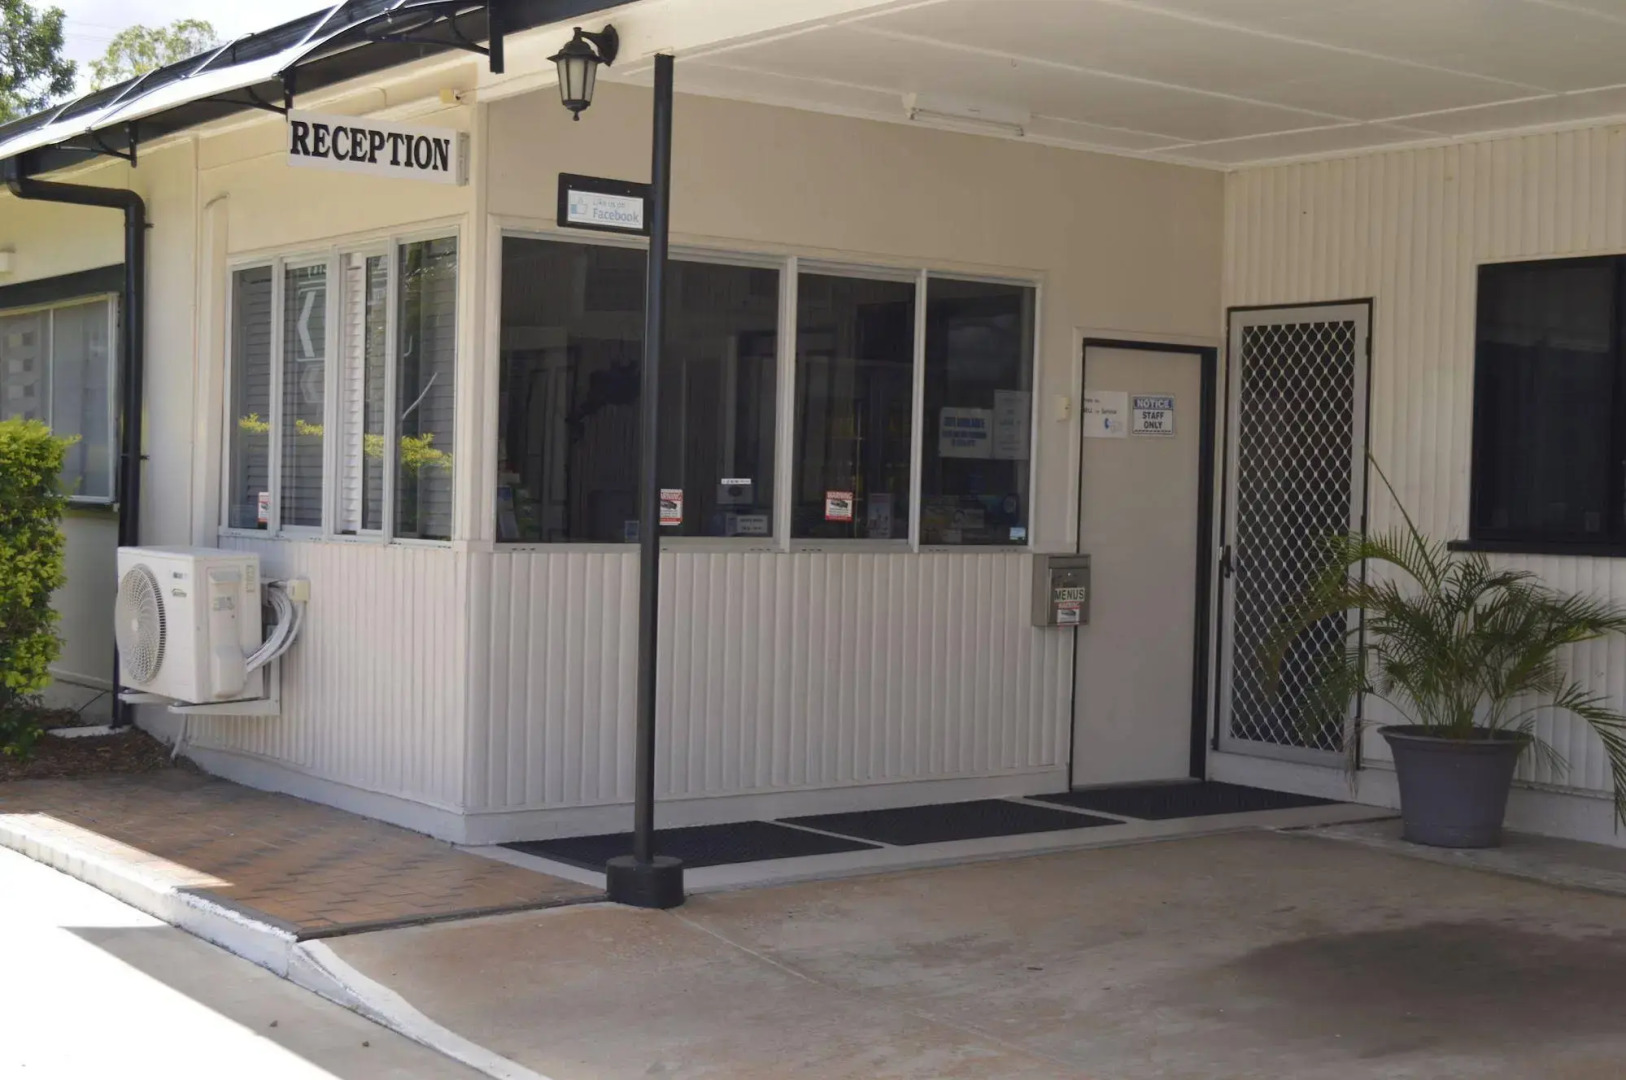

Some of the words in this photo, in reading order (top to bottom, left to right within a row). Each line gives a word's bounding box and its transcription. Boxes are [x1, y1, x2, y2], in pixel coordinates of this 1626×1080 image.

[290, 120, 450, 171] RECEPTION
[593, 208, 639, 222] Facebook
[1136, 398, 1169, 409] NOTICE
[1142, 411, 1164, 420] STAFF
[1143, 421, 1163, 429] ONLY
[1054, 589, 1084, 601] MENUS
